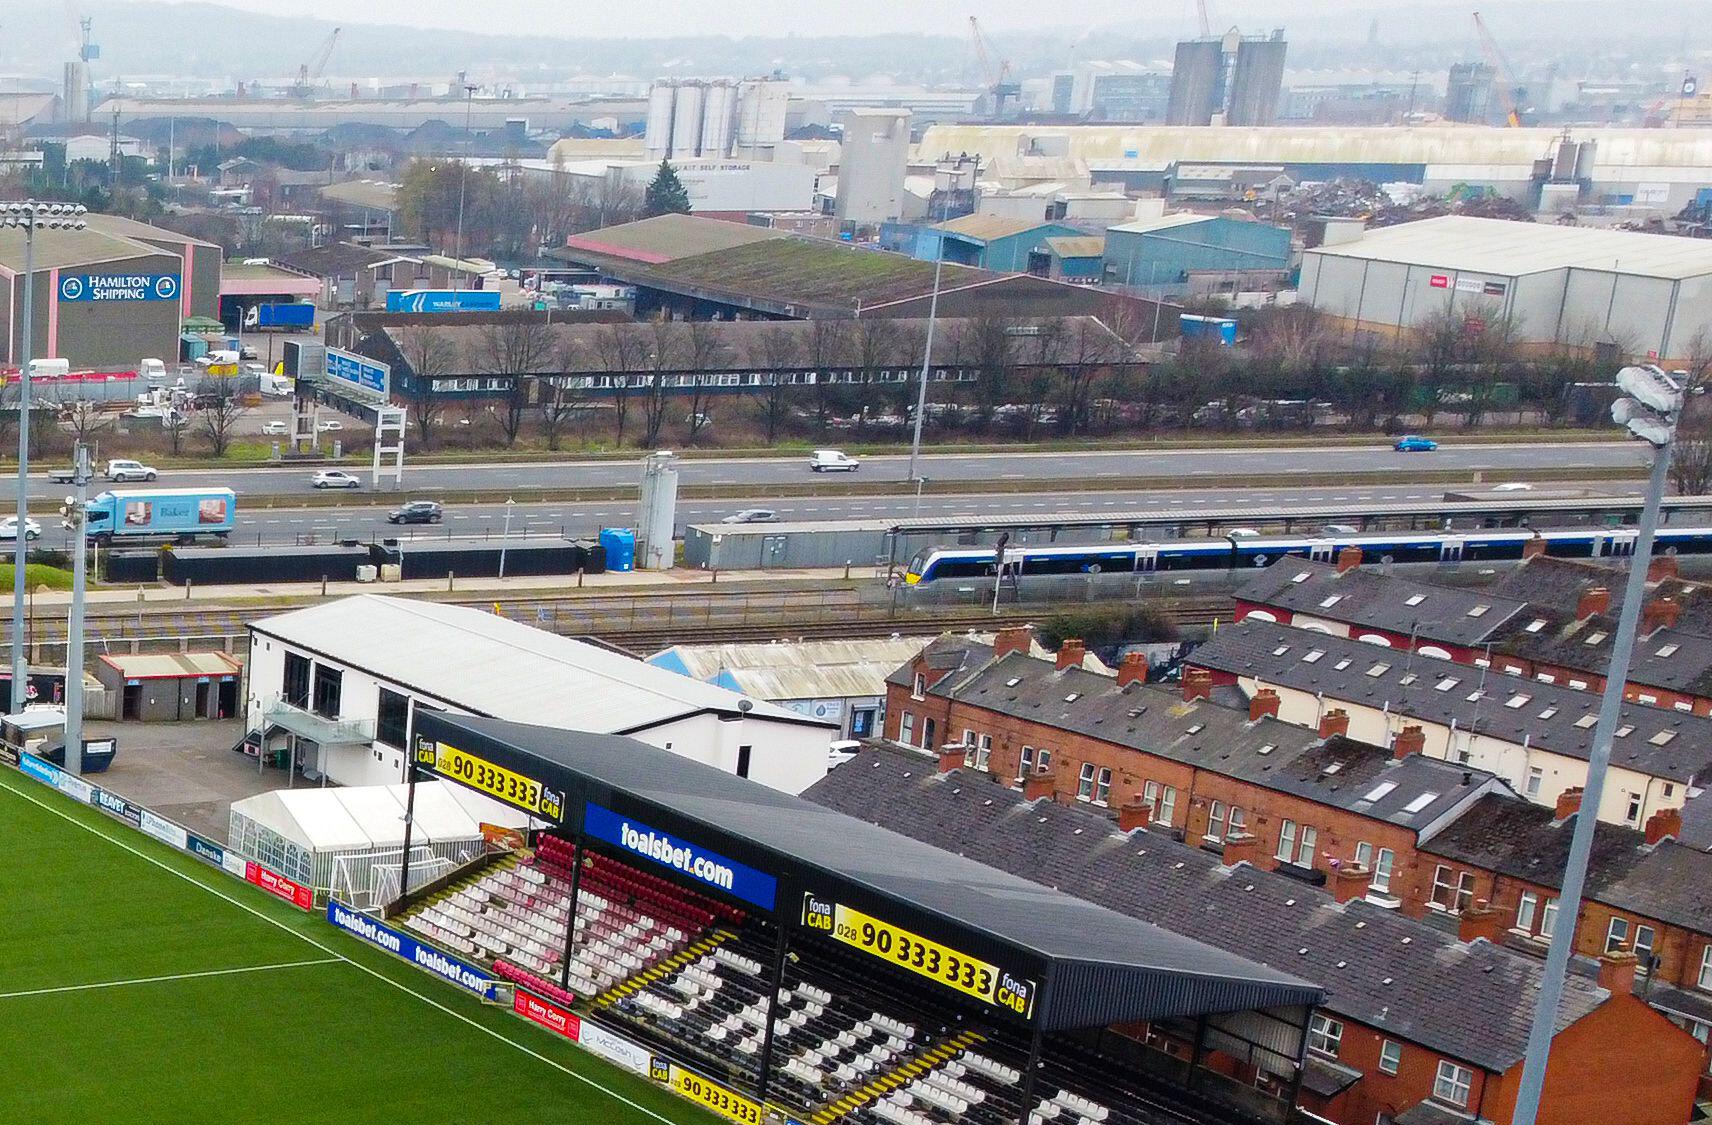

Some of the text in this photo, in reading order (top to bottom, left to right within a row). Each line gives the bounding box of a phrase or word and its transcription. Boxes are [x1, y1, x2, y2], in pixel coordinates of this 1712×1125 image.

[89, 276, 151, 289] HAMILTON
[92, 288, 146, 300] SHIPPING
[418, 749, 436, 765] CAB
[453, 755, 474, 781] 90
[477, 764, 506, 792] 333
[508, 774, 539, 806] 333
[541, 800, 561, 820] CAB
[195, 842, 222, 864] Danske
[621, 822, 735, 890] toalsbet.com
[261, 870, 278, 887] Harry
[809, 898, 831, 916] fona
[334, 907, 401, 952] toalsbet.com
[807, 912, 833, 931] CAB
[837, 922, 993, 996] 028 90 333 333
[1002, 973, 1028, 999] fona
[997, 987, 1027, 1015] CAB
[528, 999, 567, 1026] Harry Corry
[651, 1068, 669, 1081] CAB
[683, 1076, 758, 1125] 90 333 333
